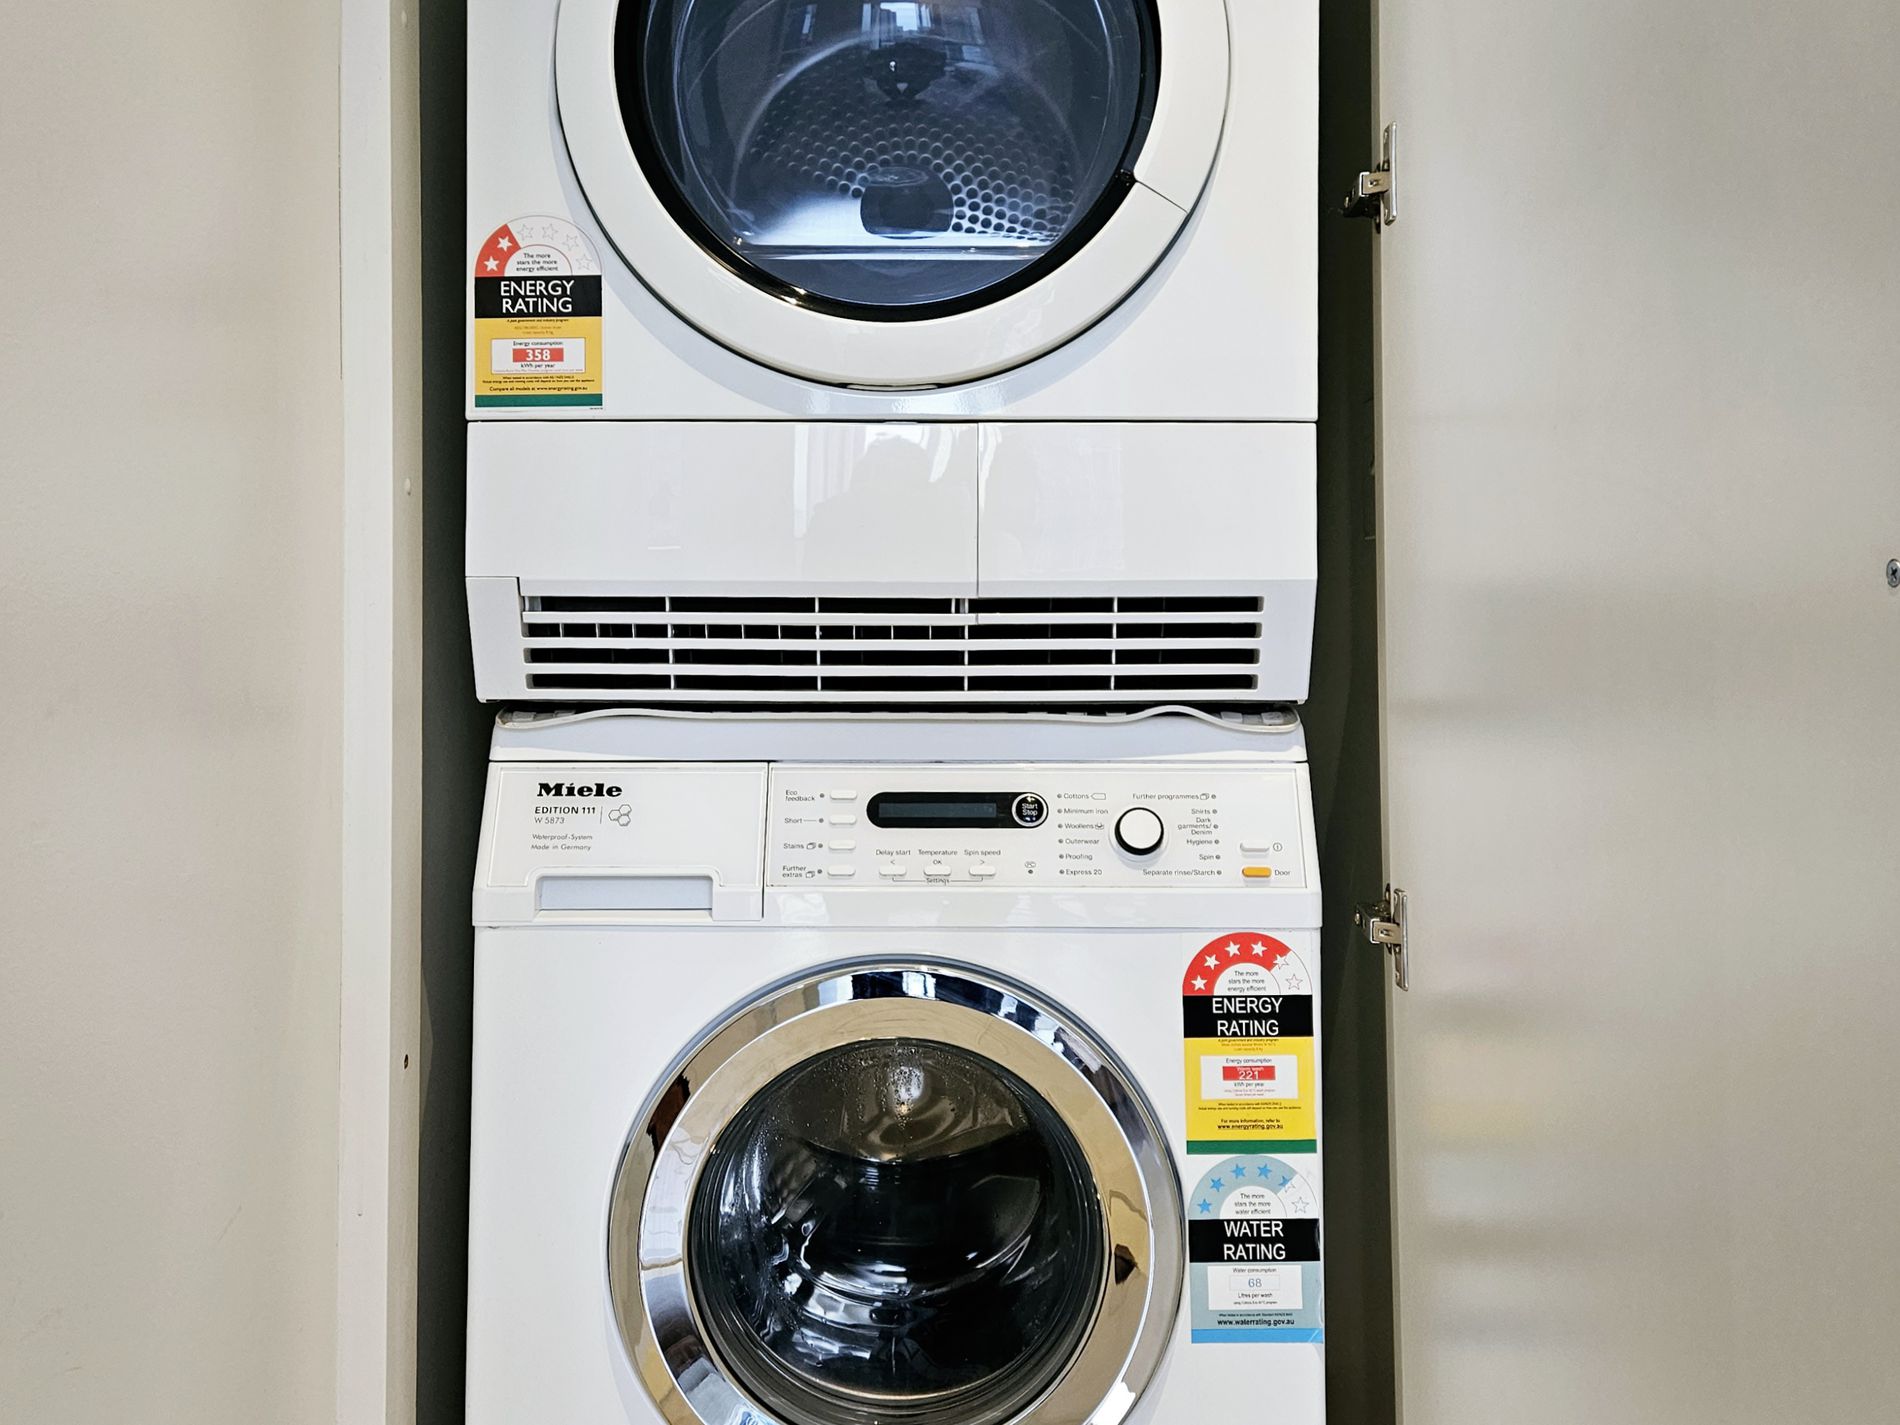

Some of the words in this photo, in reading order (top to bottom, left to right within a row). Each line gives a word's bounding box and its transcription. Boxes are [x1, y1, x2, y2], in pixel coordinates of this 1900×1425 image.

[500, 280, 574, 295] ENERGY
[502, 297, 572, 313] RATING
[526, 350, 551, 360] 358
[537, 783, 622, 797] Miele
[535, 806, 579, 814] EDITION
[1212, 997, 1283, 1014] ENERGY
[1217, 1020, 1279, 1036] RATING
[1239, 1071, 1259, 1080] 221
[1224, 1221, 1284, 1237] WATER
[1223, 1244, 1286, 1260] RATING
[1248, 1279, 1262, 1287] 68
